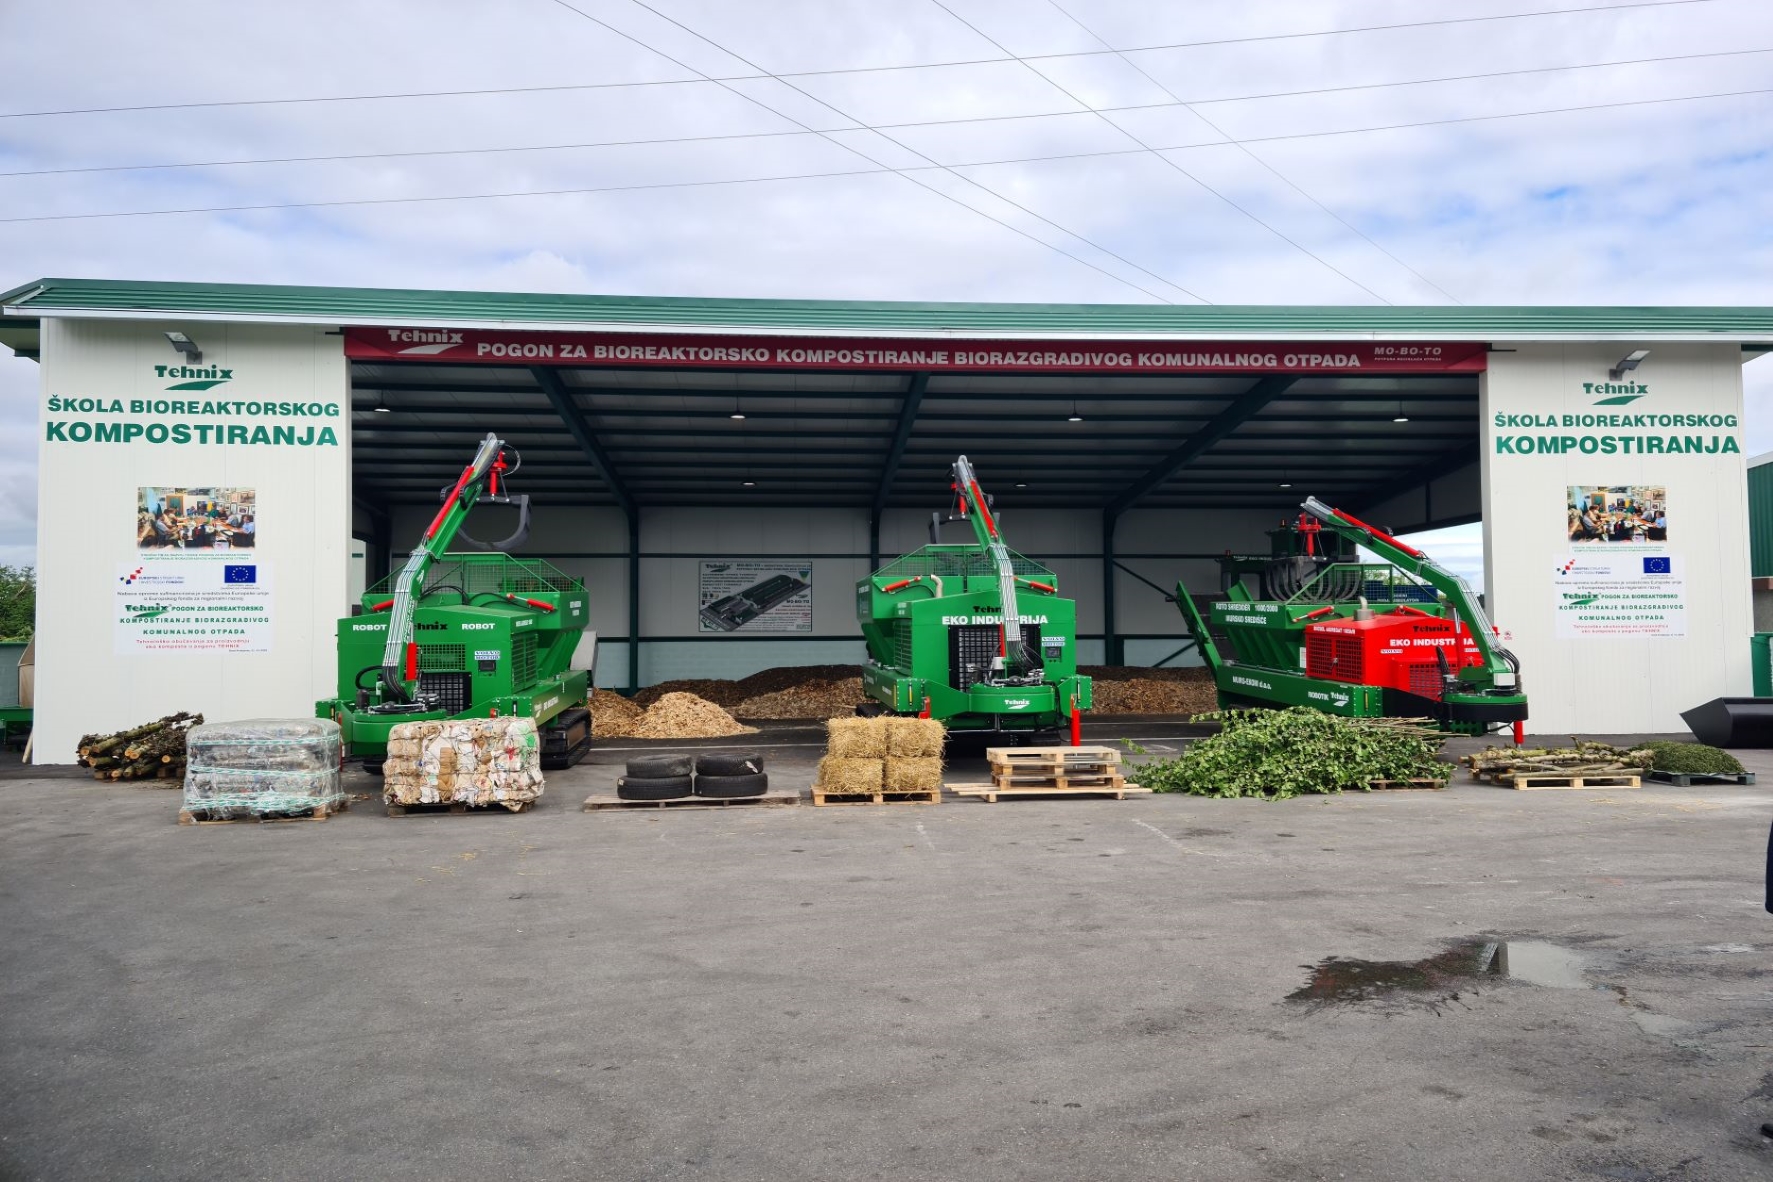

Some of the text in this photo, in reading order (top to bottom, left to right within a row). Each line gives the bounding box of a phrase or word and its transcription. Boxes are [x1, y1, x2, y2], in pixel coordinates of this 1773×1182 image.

[388, 329, 463, 344] Tehnix
[477, 343, 1361, 368] POGON ZA BIOREAKTORSKO KOMPOSTIRANJE BIORAZGRADIVOG KOMUNALNOG OTPADA
[1374, 347, 1442, 355] MO-BO-TO
[154, 364, 234, 380] Tehnix
[1582, 381, 1649, 395] Tehnix
[47, 394, 340, 417] ŠKOLA BIOREAKTORSKOG
[1494, 411, 1738, 428] ŠKOLA BIOREAKTORSKOG
[46, 421, 339, 447] KOMPOSTIRANJA
[1495, 435, 1741, 455] KOMPOSTIRANJA
[125, 603, 169, 612] Tehnix
[414, 621, 448, 630] hnix
[942, 614, 1048, 625] EKO INDURIJA
[1412, 624, 1450, 632] Tehnix
[1390, 638, 1410, 646] EKO
